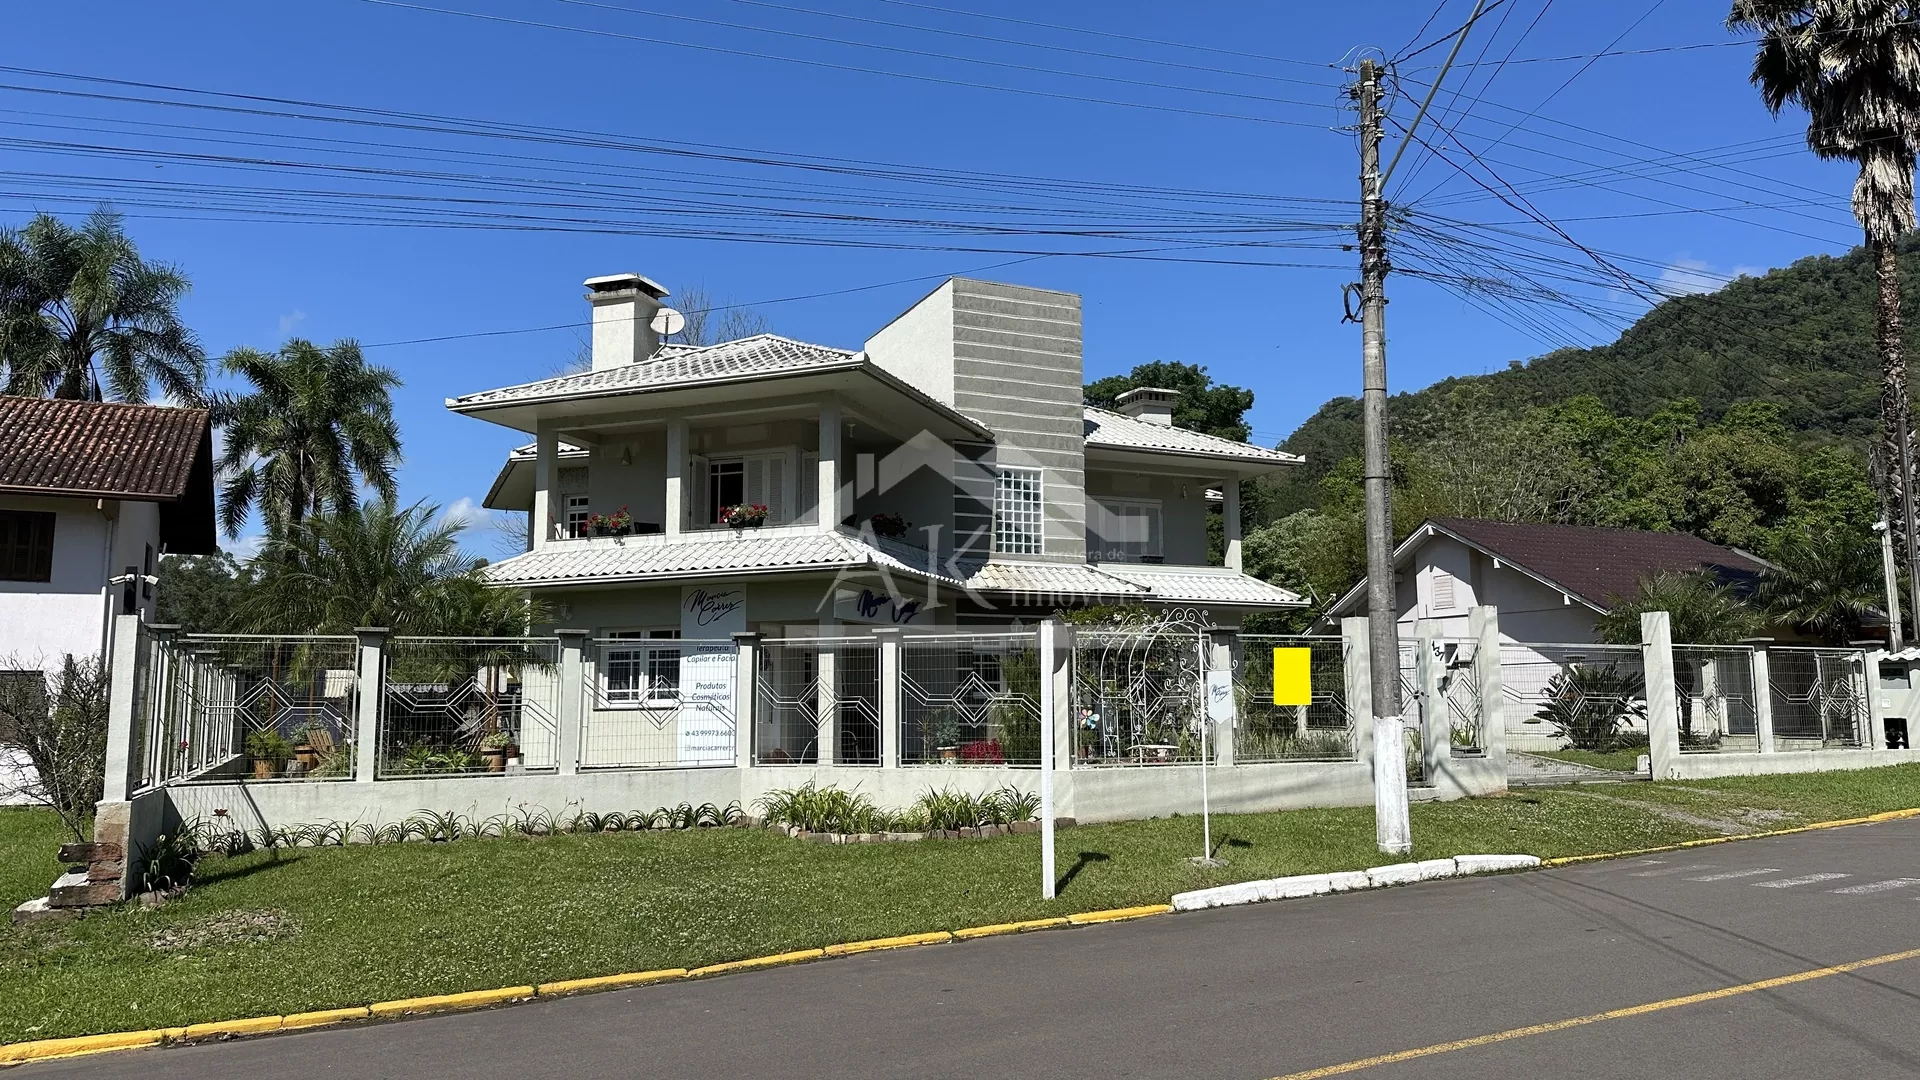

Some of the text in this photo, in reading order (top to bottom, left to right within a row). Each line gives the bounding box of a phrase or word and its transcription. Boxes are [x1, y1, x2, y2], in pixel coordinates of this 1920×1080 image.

[687, 655, 710, 664] Capilar
[695, 682, 727, 690] Produtos
[695, 703, 726, 712] Naturais
